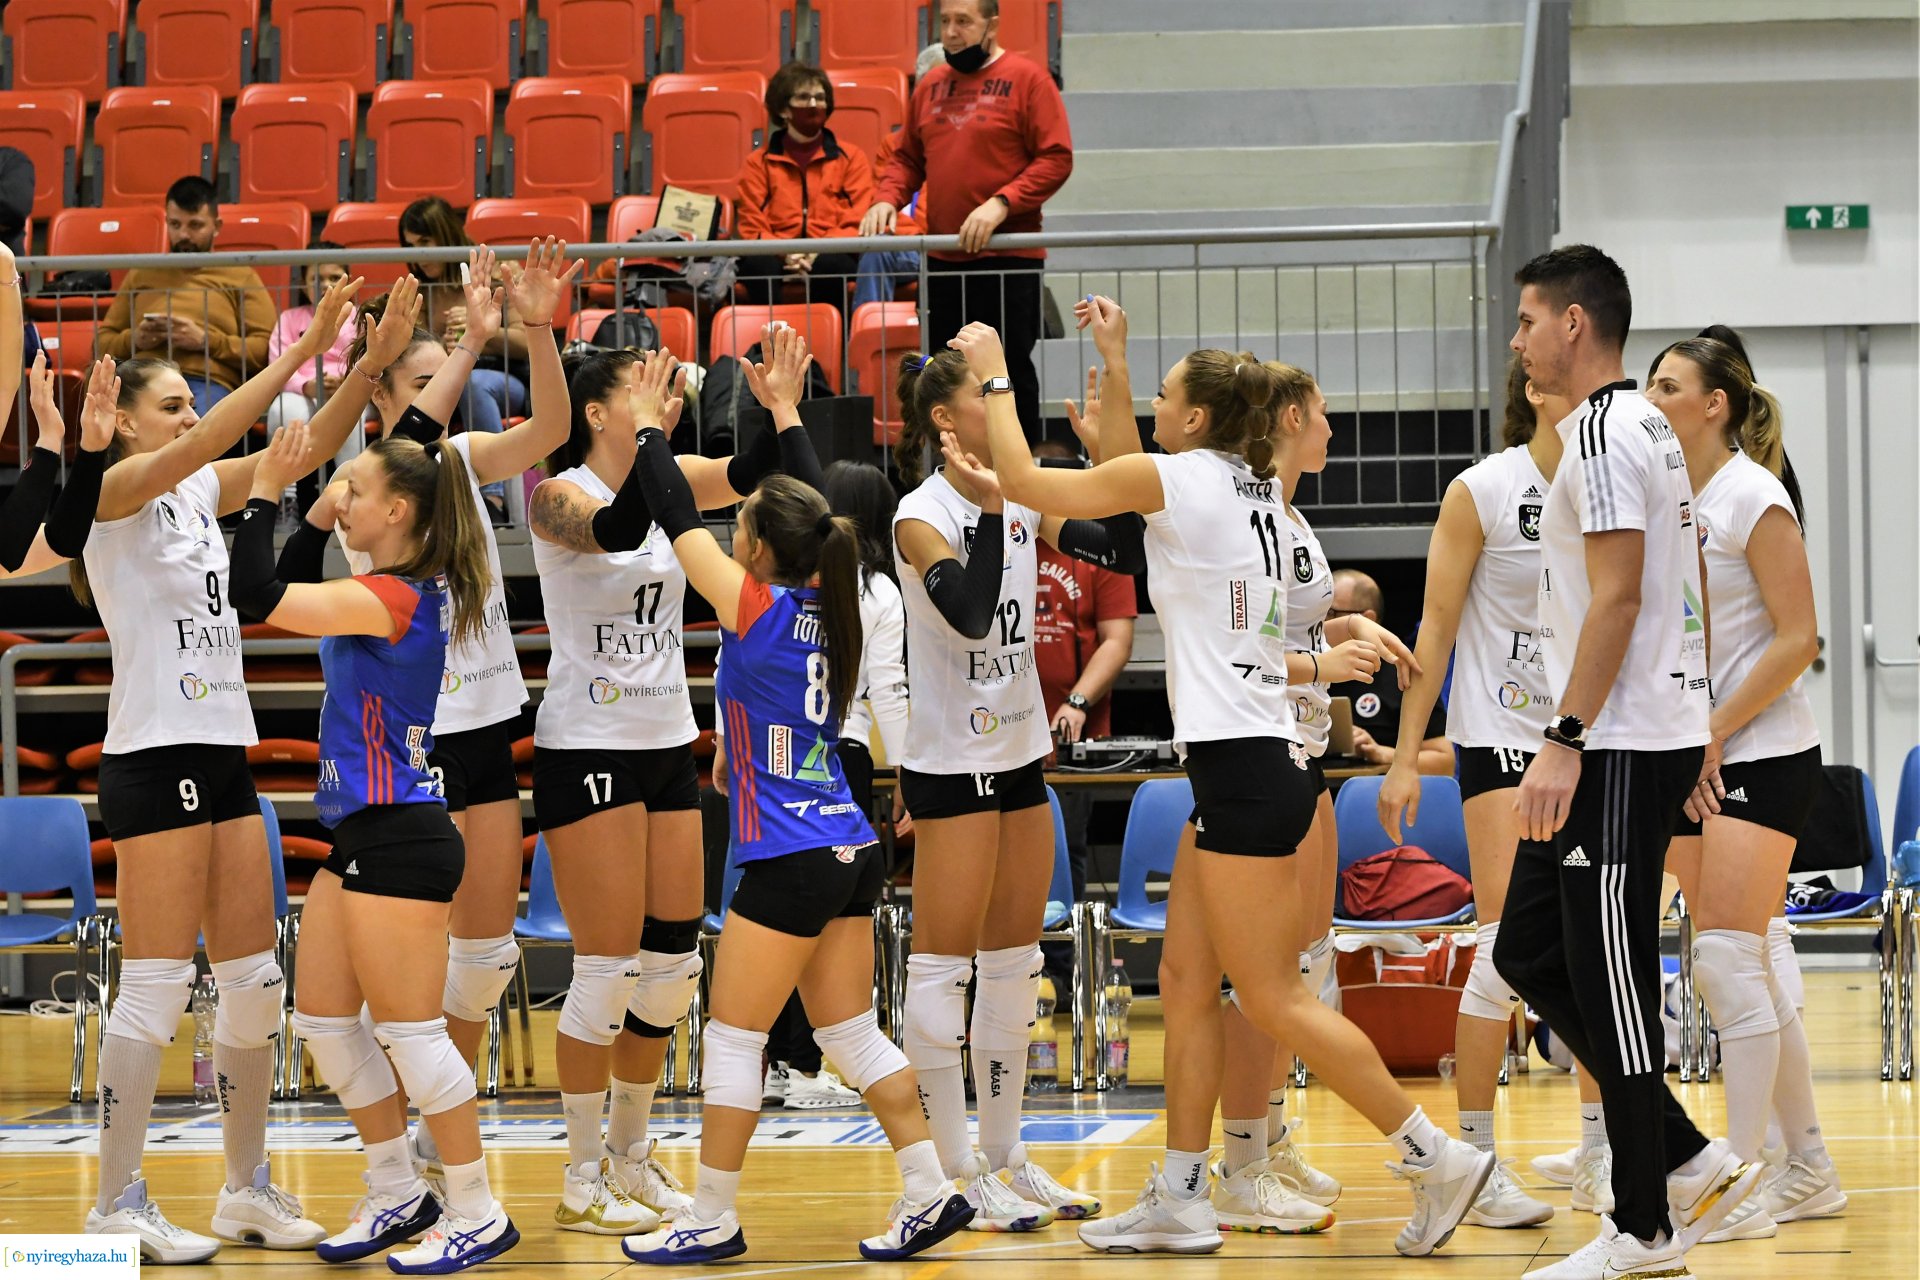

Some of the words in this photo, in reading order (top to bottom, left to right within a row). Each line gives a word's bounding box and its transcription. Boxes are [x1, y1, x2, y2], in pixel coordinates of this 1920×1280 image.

[1526, 506, 1540, 514] CEV
[1249, 509, 1282, 581] 11
[205, 570, 222, 617] 9
[633, 580, 664, 625] 17
[1233, 580, 1245, 630] STRABAG
[995, 598, 1026, 647] 12
[804, 652, 831, 726] 8
[776, 727, 785, 777] STRABAG
[1493, 746, 1525, 773] 19
[178, 778, 199, 812] 9
[583, 772, 613, 805] 17
[1726, 792, 1749, 803] adidas
[1563, 858, 1591, 867] adidas
[217, 1072, 234, 1114] MIKASA
[990, 1060, 1005, 1098] MIKASA
[103, 1085, 116, 1130] MIKASA
[1186, 1162, 1202, 1192] MIKASA
